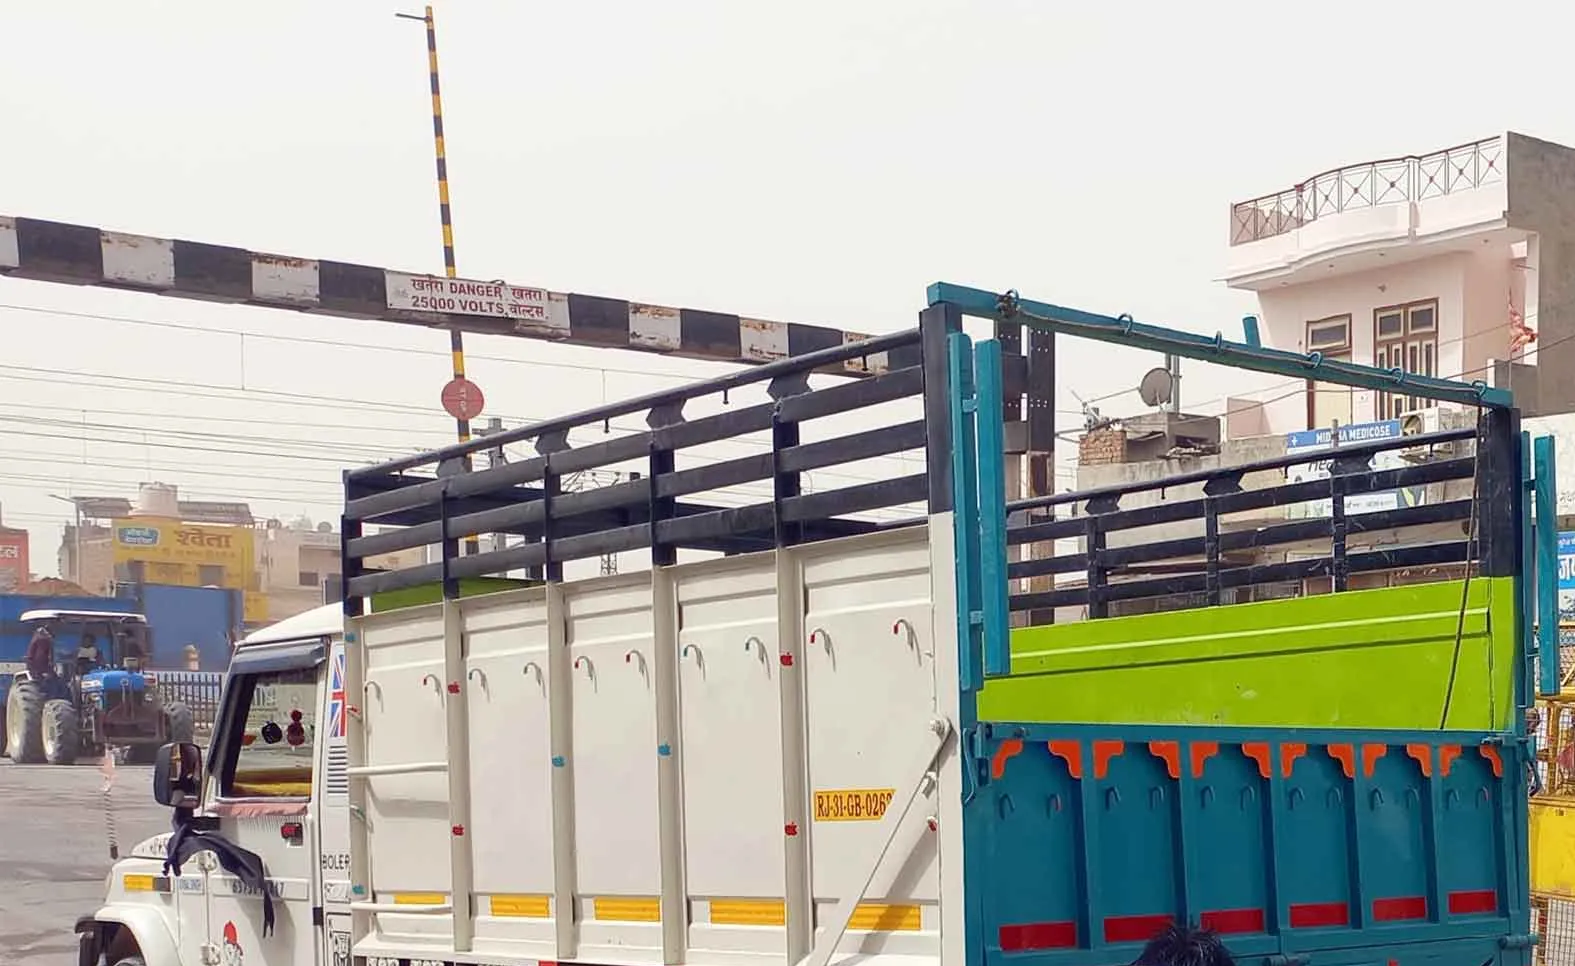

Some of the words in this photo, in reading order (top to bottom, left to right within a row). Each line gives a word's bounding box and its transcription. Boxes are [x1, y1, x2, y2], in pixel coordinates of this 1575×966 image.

[411, 278, 444, 293] खतरा
[449, 282, 503, 298] DANGER
[511, 287, 542, 301] खतरा
[411, 295, 455, 310] 25000
[460, 299, 505, 314] VOLTS
[1349, 424, 1391, 441] MEDICOSE
